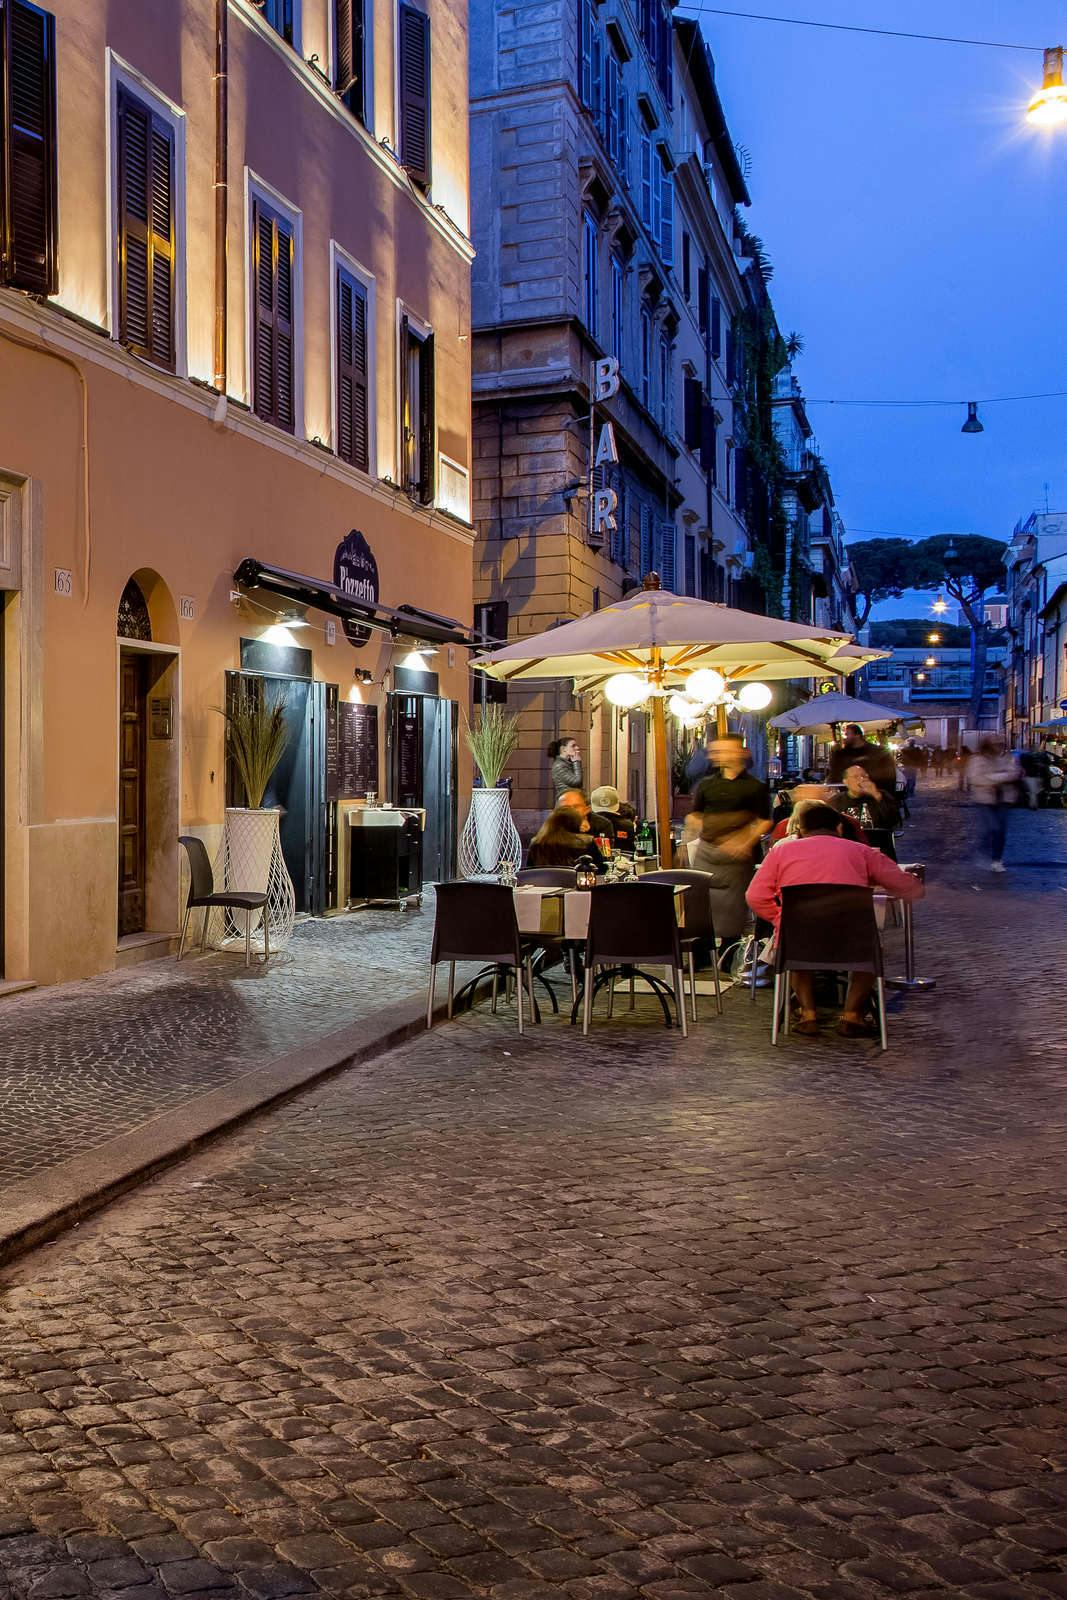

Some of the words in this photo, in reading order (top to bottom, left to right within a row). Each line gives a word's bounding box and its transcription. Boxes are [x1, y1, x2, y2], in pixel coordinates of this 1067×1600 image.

[594, 356, 620, 533] BAR
[54, 570, 72, 593] 165
[180, 598, 194, 618] 166
